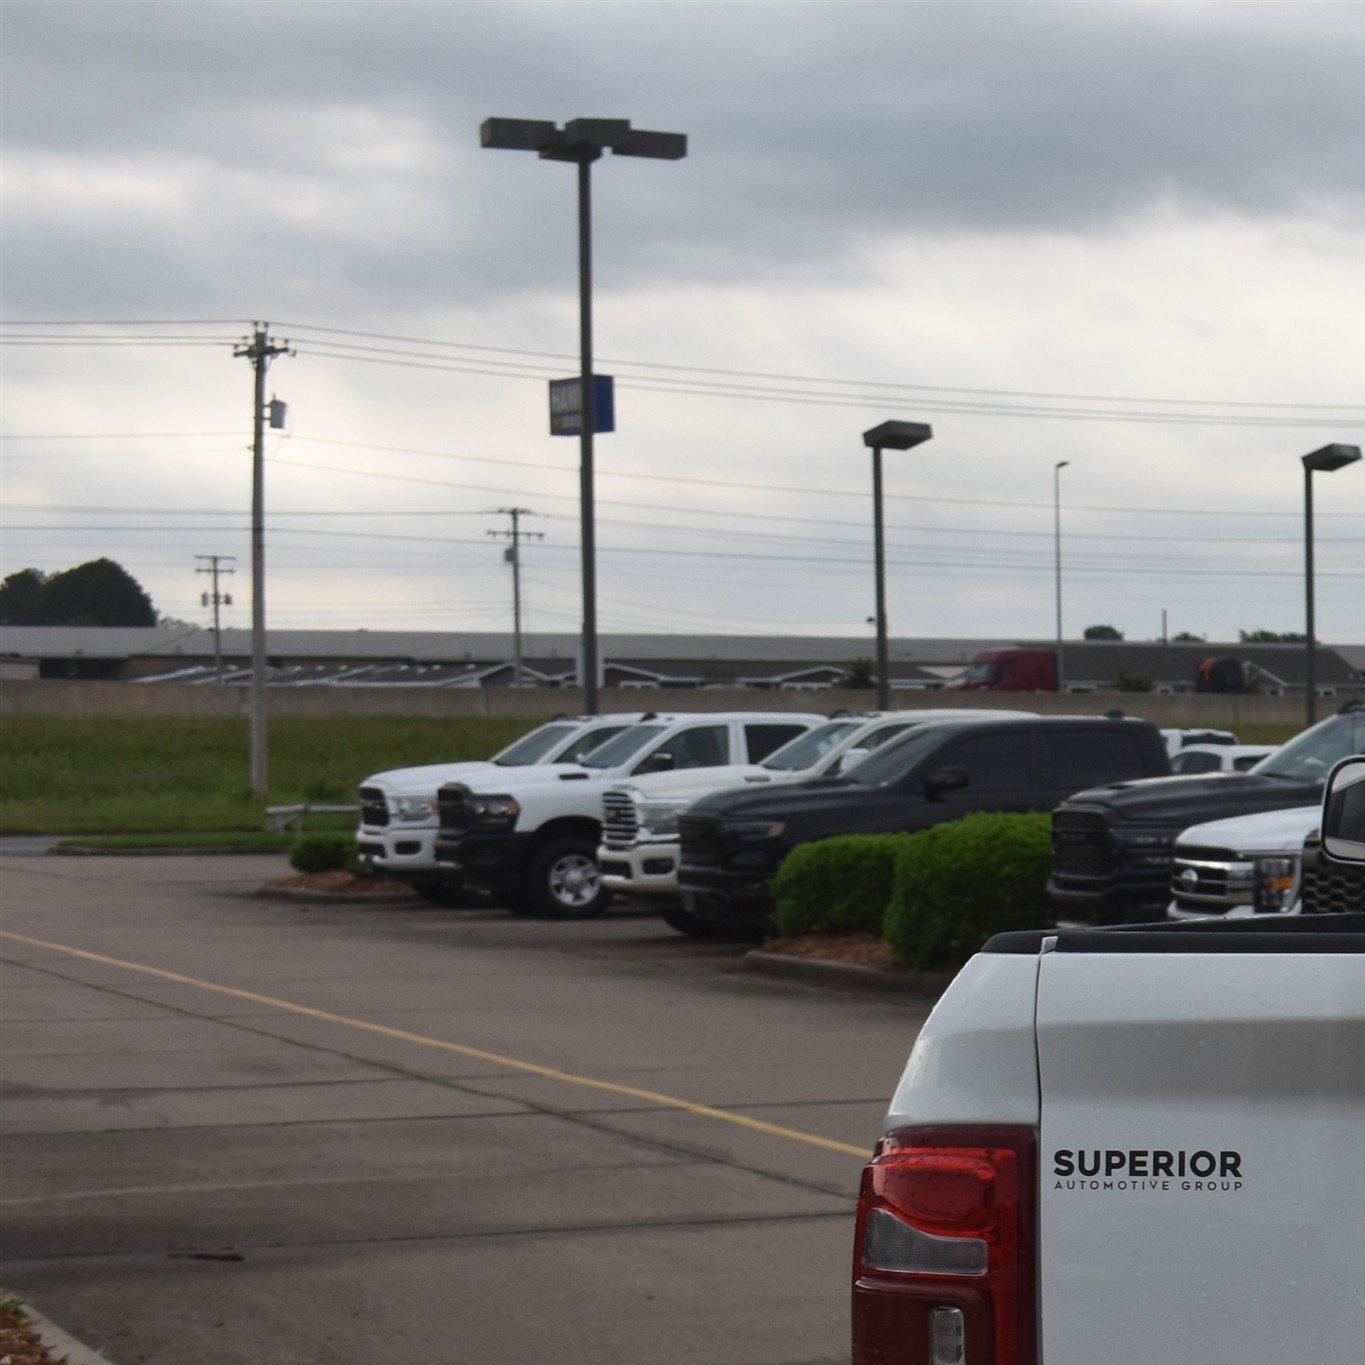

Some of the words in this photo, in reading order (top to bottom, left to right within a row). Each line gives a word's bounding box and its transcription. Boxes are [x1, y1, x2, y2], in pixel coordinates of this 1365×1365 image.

[1053, 1149, 1243, 1178] SUPERIOR
[1054, 1180, 1170, 1191] AUTOMOTIVE
[1181, 1181, 1243, 1191] GROUP
